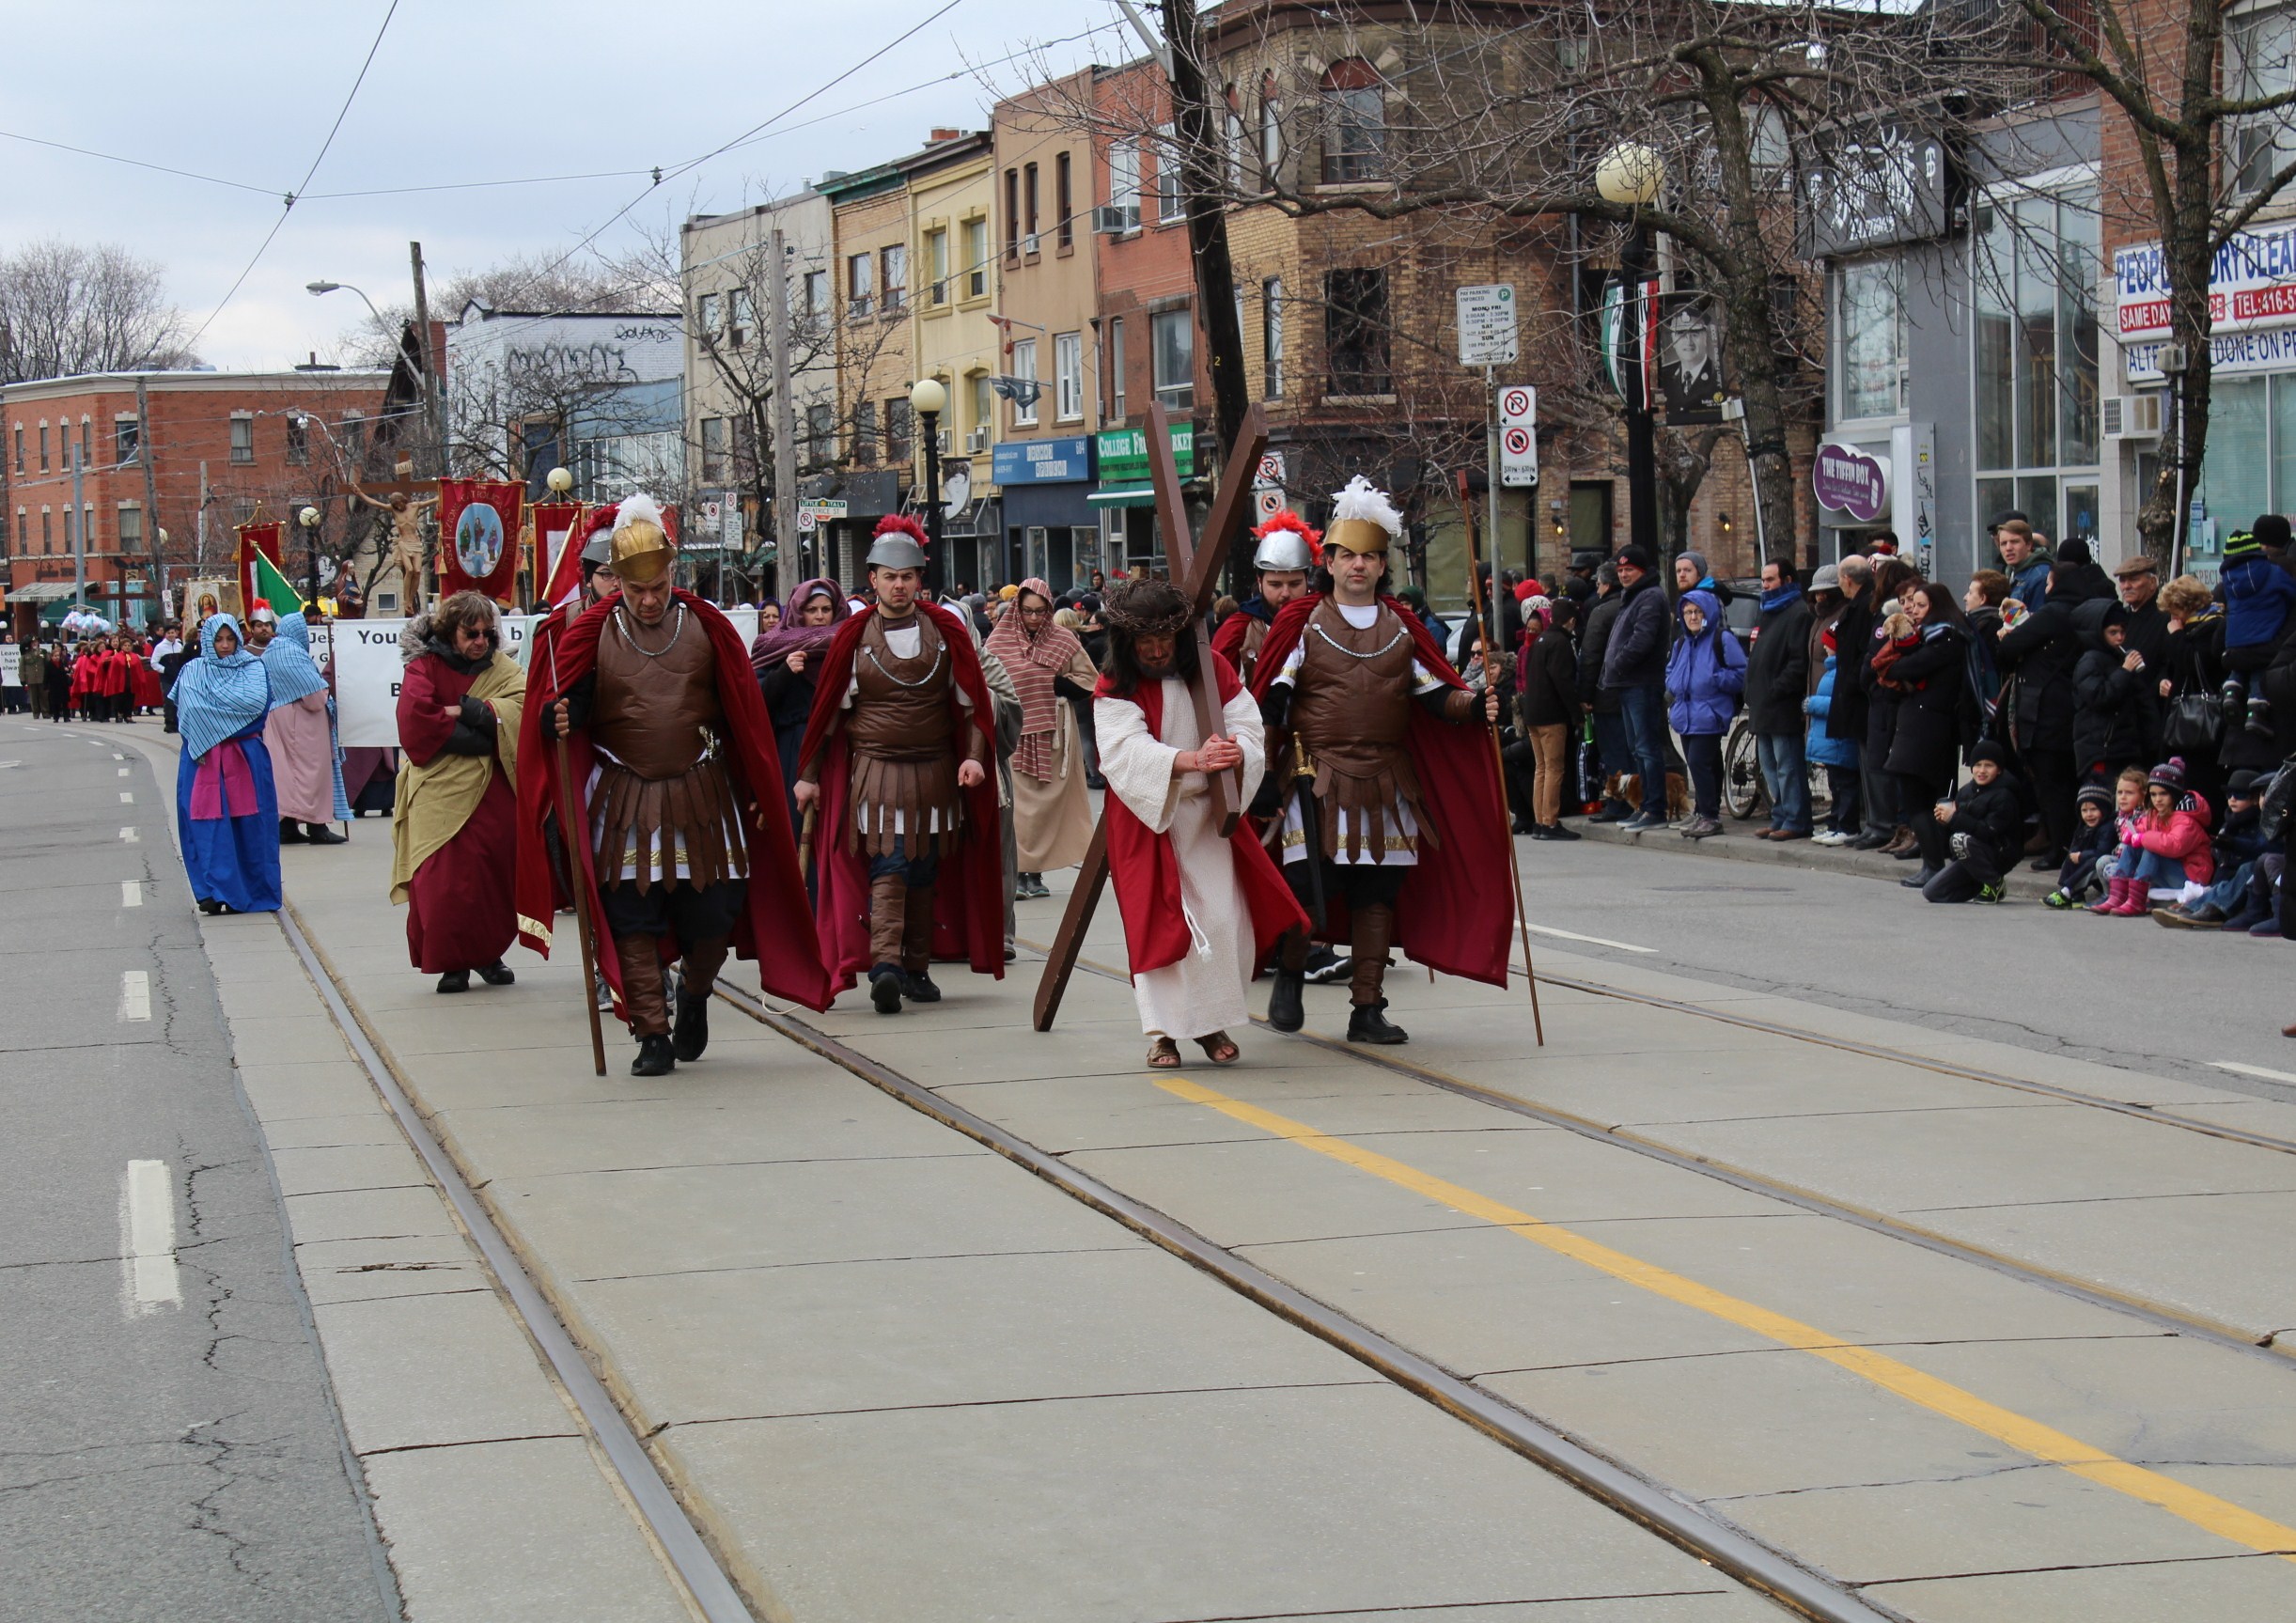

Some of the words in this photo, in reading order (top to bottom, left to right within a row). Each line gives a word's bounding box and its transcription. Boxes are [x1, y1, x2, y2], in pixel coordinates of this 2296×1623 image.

[2244, 229, 2296, 280] CLEA
[2121, 305, 2150, 329] SAME
[1214, 355, 1221, 367] 2
[2129, 345, 2159, 372] ALTE
[2214, 335, 2255, 363] DONE
[2258, 332, 2280, 360] ON
[1099, 435, 1131, 458] COLLEGE
[1132, 432, 1148, 455] FRU
[1171, 433, 1193, 452] RKET
[1822, 457, 1835, 478] THE
[1835, 460, 1855, 482] TIFFIN
[1855, 463, 1869, 486] BOX
[358, 630, 398, 645] You
